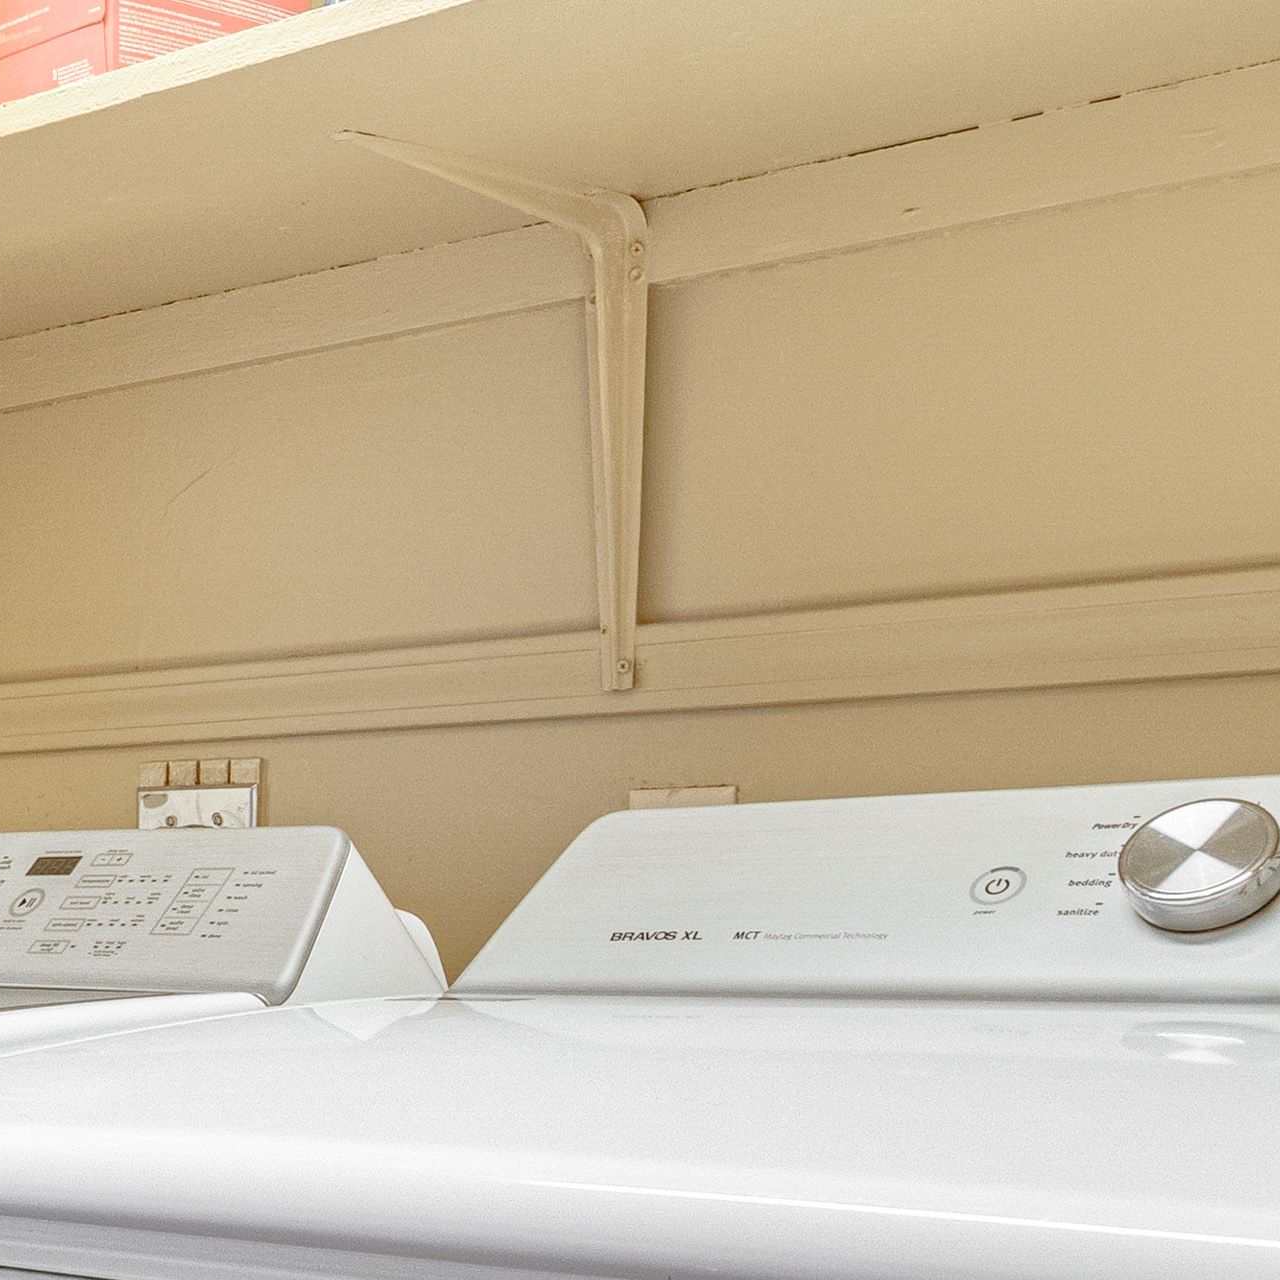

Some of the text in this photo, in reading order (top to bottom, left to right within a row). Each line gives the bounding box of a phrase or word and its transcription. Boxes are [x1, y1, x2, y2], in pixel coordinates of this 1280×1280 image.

[1065, 850, 1120, 860] heavy dut
[1068, 878, 1112, 888] bedding
[1056, 908, 1100, 917] sanitize
[610, 931, 703, 942] BRAVOS XL
[732, 930, 762, 940] MCT
